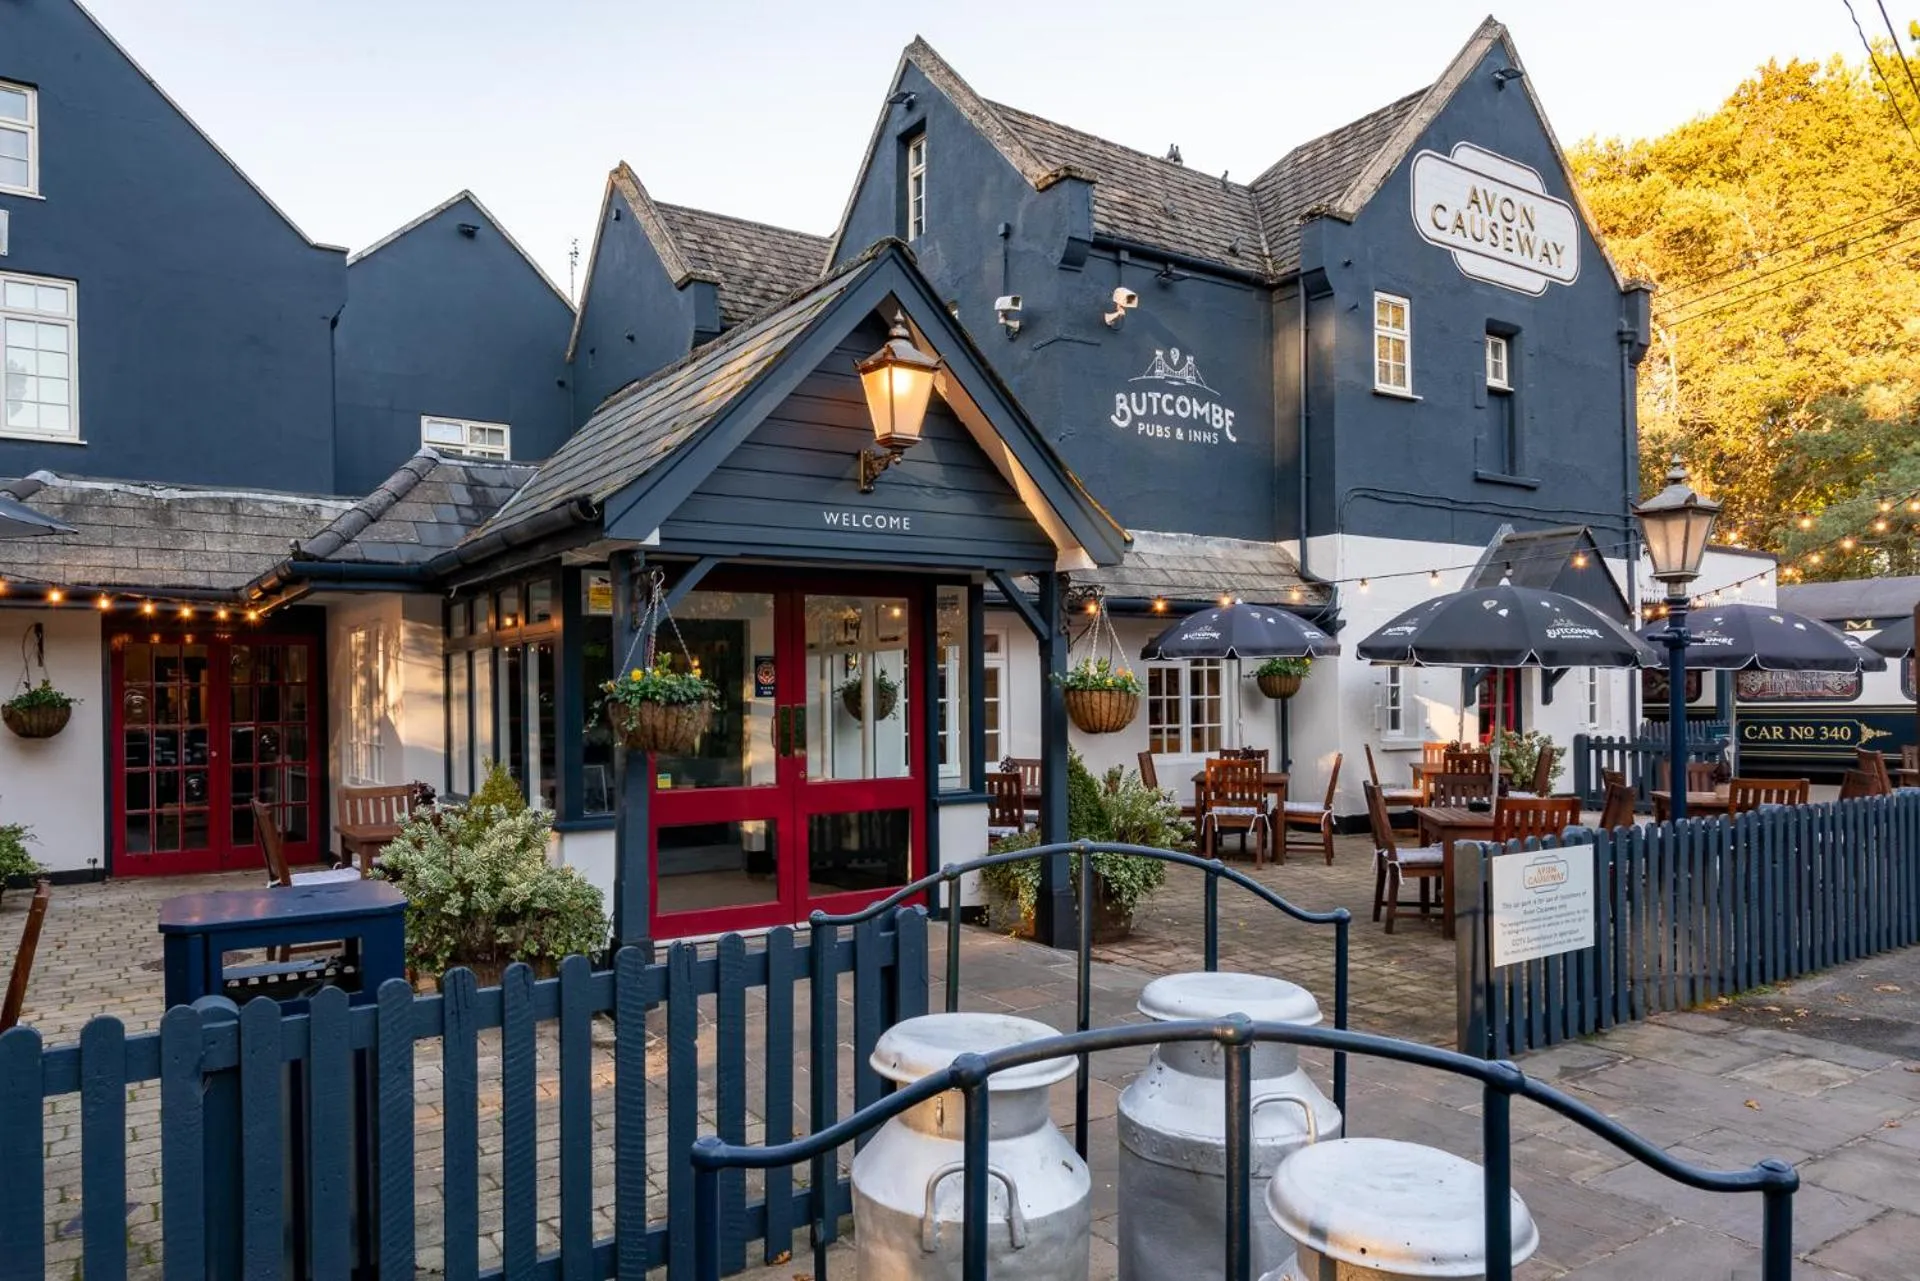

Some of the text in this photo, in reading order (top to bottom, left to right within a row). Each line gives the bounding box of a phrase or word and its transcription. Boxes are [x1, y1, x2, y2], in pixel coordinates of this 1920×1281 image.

[1467, 185, 1536, 232] AVON
[1430, 203, 1566, 269] CAUSEWAY
[1110, 391, 1237, 443] BUTCOMBE
[1137, 422, 1219, 445] PUBS & INNS
[823, 511, 911, 531] WELCOME
[1744, 725, 1787, 741] CAR
[1819, 725, 1851, 741] 340
